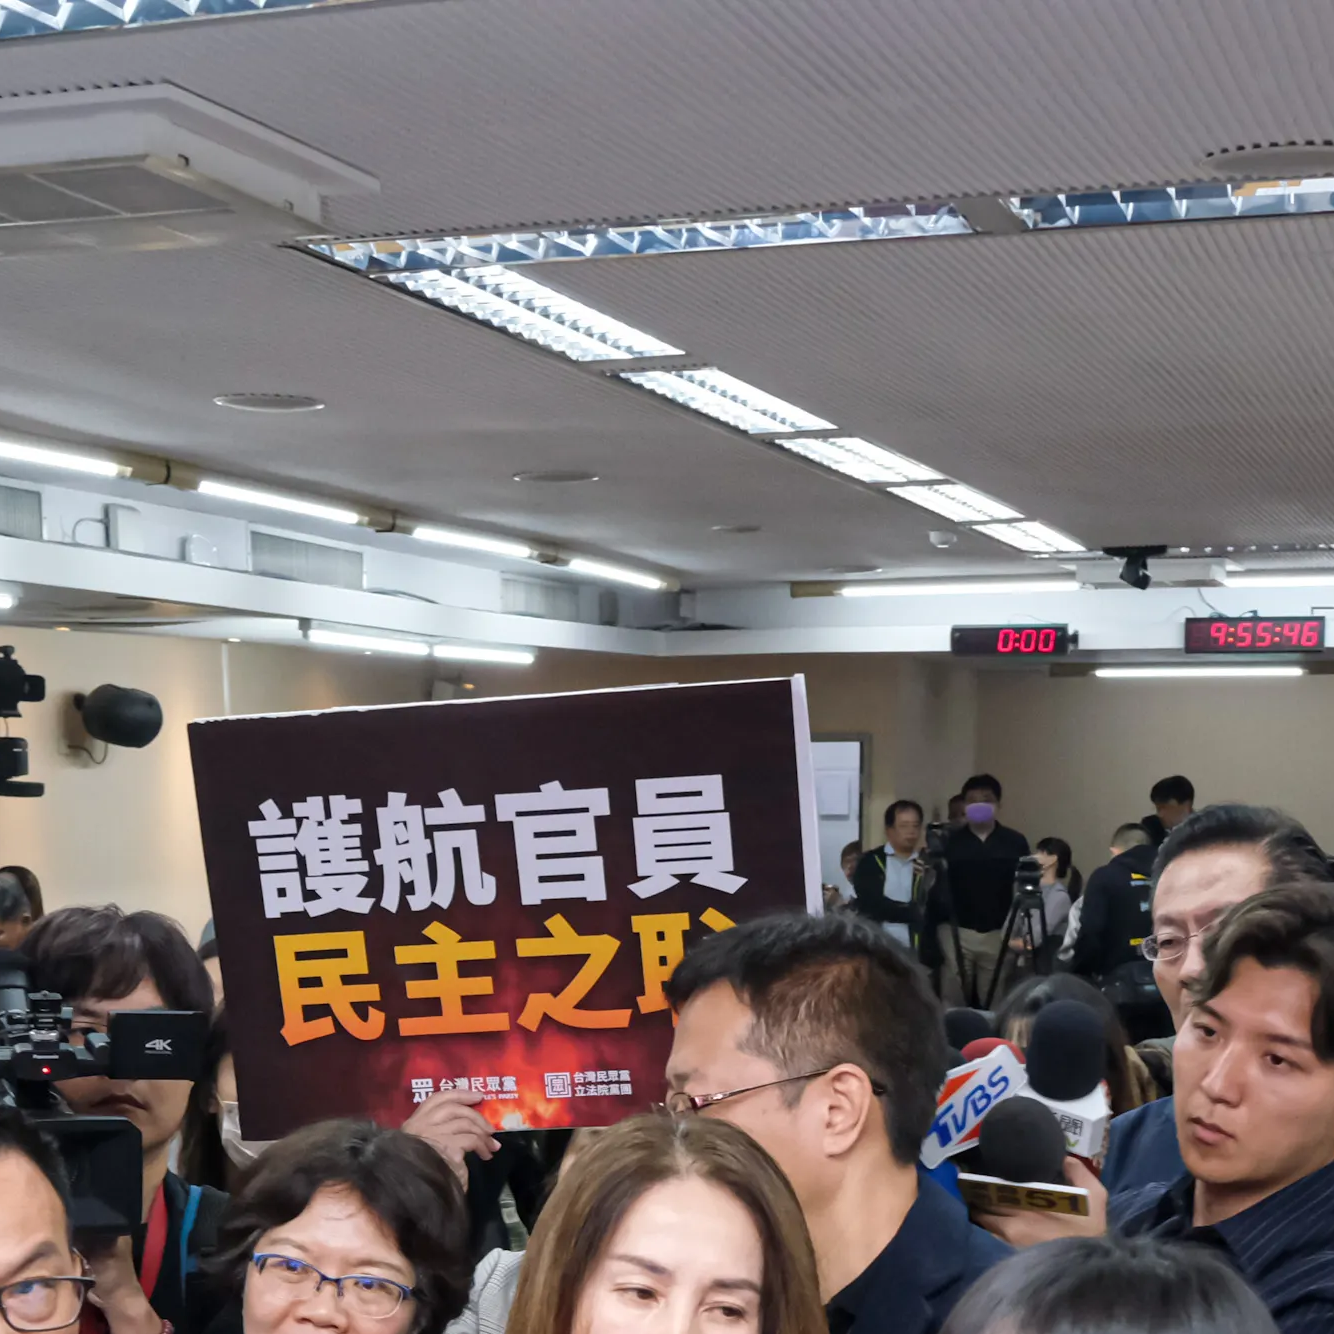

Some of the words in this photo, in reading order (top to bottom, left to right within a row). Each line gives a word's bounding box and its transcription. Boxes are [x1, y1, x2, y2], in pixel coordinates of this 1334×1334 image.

[997, 628, 1056, 653] 0:00
[1209, 620, 1320, 648] 9:55:46
[247, 773, 748, 919] 護航官員
[144, 1038, 173, 1052] 4K
[573, 1069, 630, 1084] 台灣民眾黨
[574, 1083, 633, 1097] 立法院黨團
[927, 1065, 1010, 1149] TVBS
